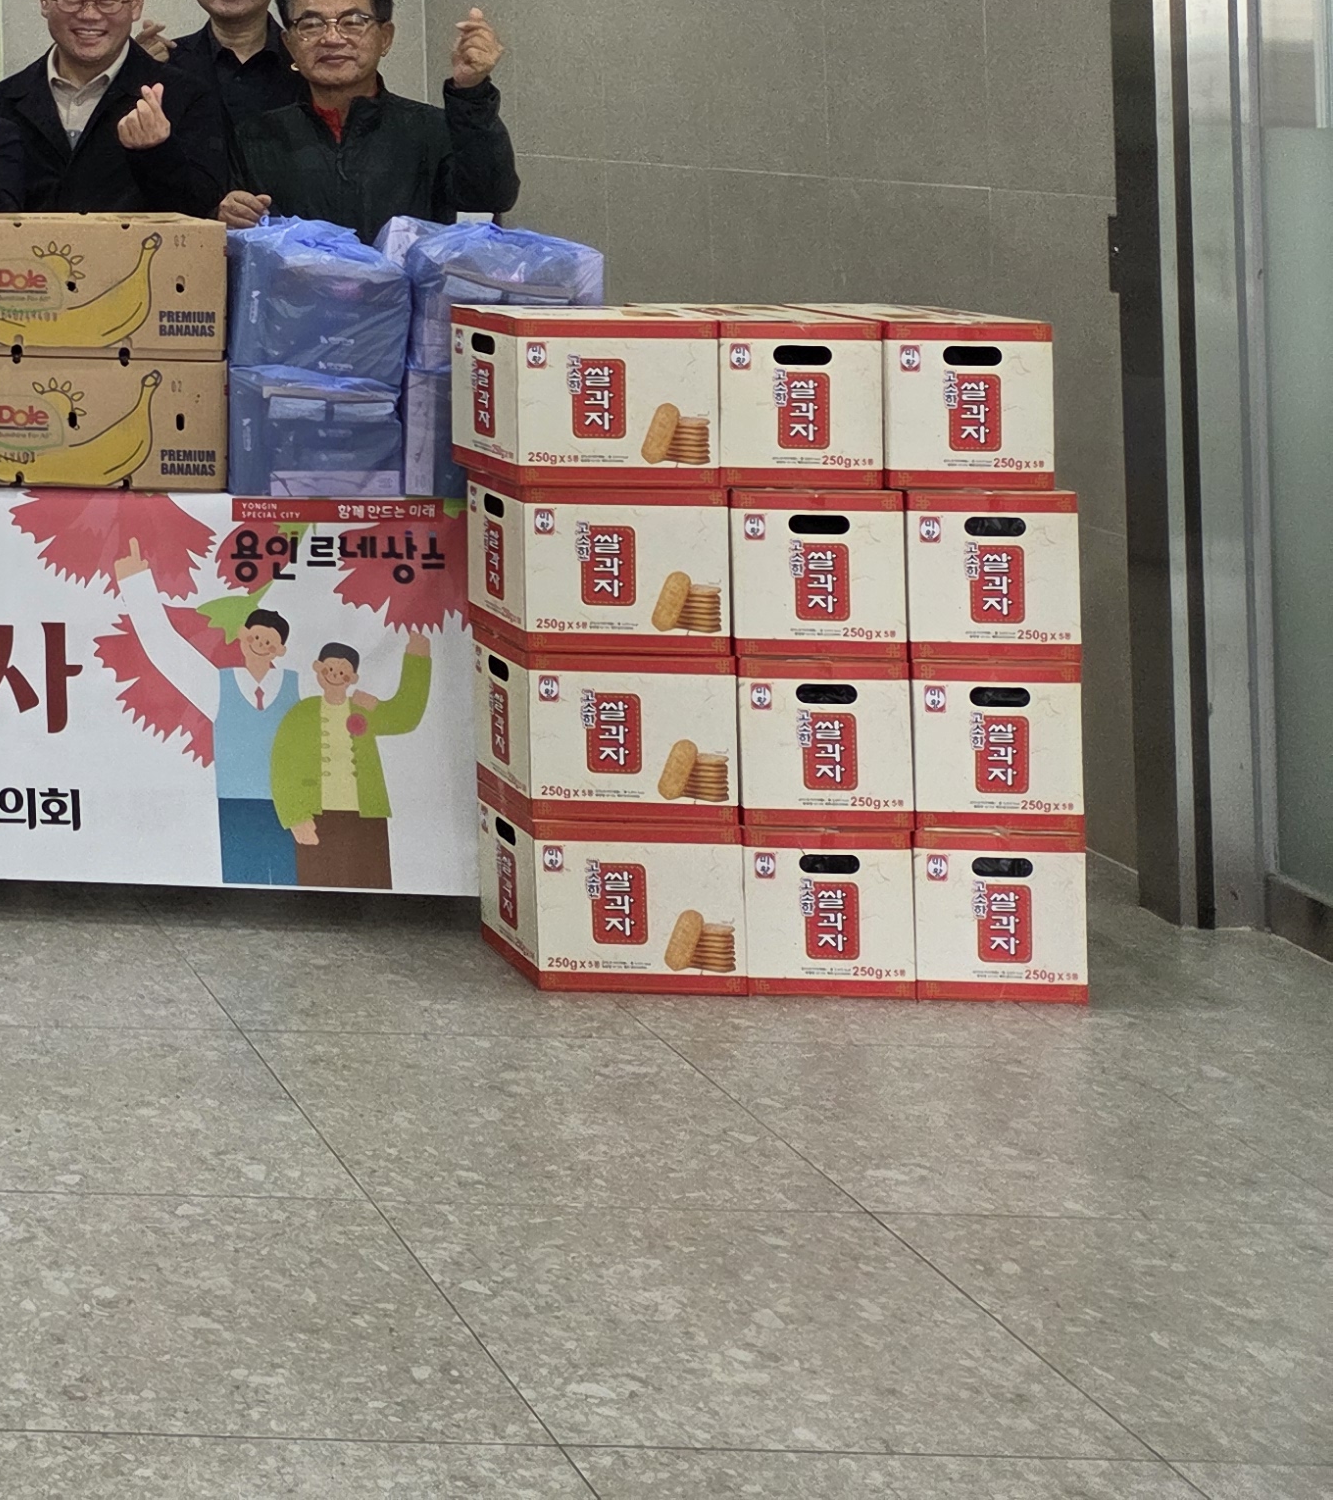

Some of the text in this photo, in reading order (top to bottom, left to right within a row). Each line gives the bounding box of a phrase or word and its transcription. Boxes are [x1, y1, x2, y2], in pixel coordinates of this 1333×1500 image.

[159, 311, 216, 324] PREMIUM
[159, 324, 215, 337] BANANAS
[567, 354, 582, 395] 고소한
[943, 369, 958, 410] 고소한
[584, 366, 614, 431] 쌀과자
[789, 379, 819, 442] 쌀과자
[960, 381, 990, 444] 쌀과자
[160, 449, 216, 463] PREMIUM
[160, 463, 216, 476] BANANAS
[527, 452, 558, 465] 250g
[993, 457, 1023, 471] 250g
[241, 502, 278, 510] YONGIN
[241, 511, 301, 519] SPECIAL CITY
[337, 504, 436, 519] 함께 만드는 미래
[230, 530, 445, 585] 용인 르네상스
[593, 533, 624, 598] 쌀과자
[789, 538, 804, 578] 고소한
[807, 551, 837, 613] 쌀과자
[982, 553, 1012, 616] 쌀과자
[842, 626, 873, 640] 250g
[581, 688, 596, 730] 고소한
[598, 700, 629, 766] 쌀과자
[970, 711, 985, 751] 고소한
[814, 720, 845, 783] 쌀과자
[987, 723, 1017, 786] 쌀과자
[541, 785, 572, 799] 250g
[1021, 799, 1052, 813] 250g
[604, 871, 635, 937] 쌀과자
[800, 877, 815, 917] 고소한
[817, 889, 848, 952] 쌀과자
[990, 891, 1019, 955] 쌀과자
[852, 966, 883, 979] 250g
